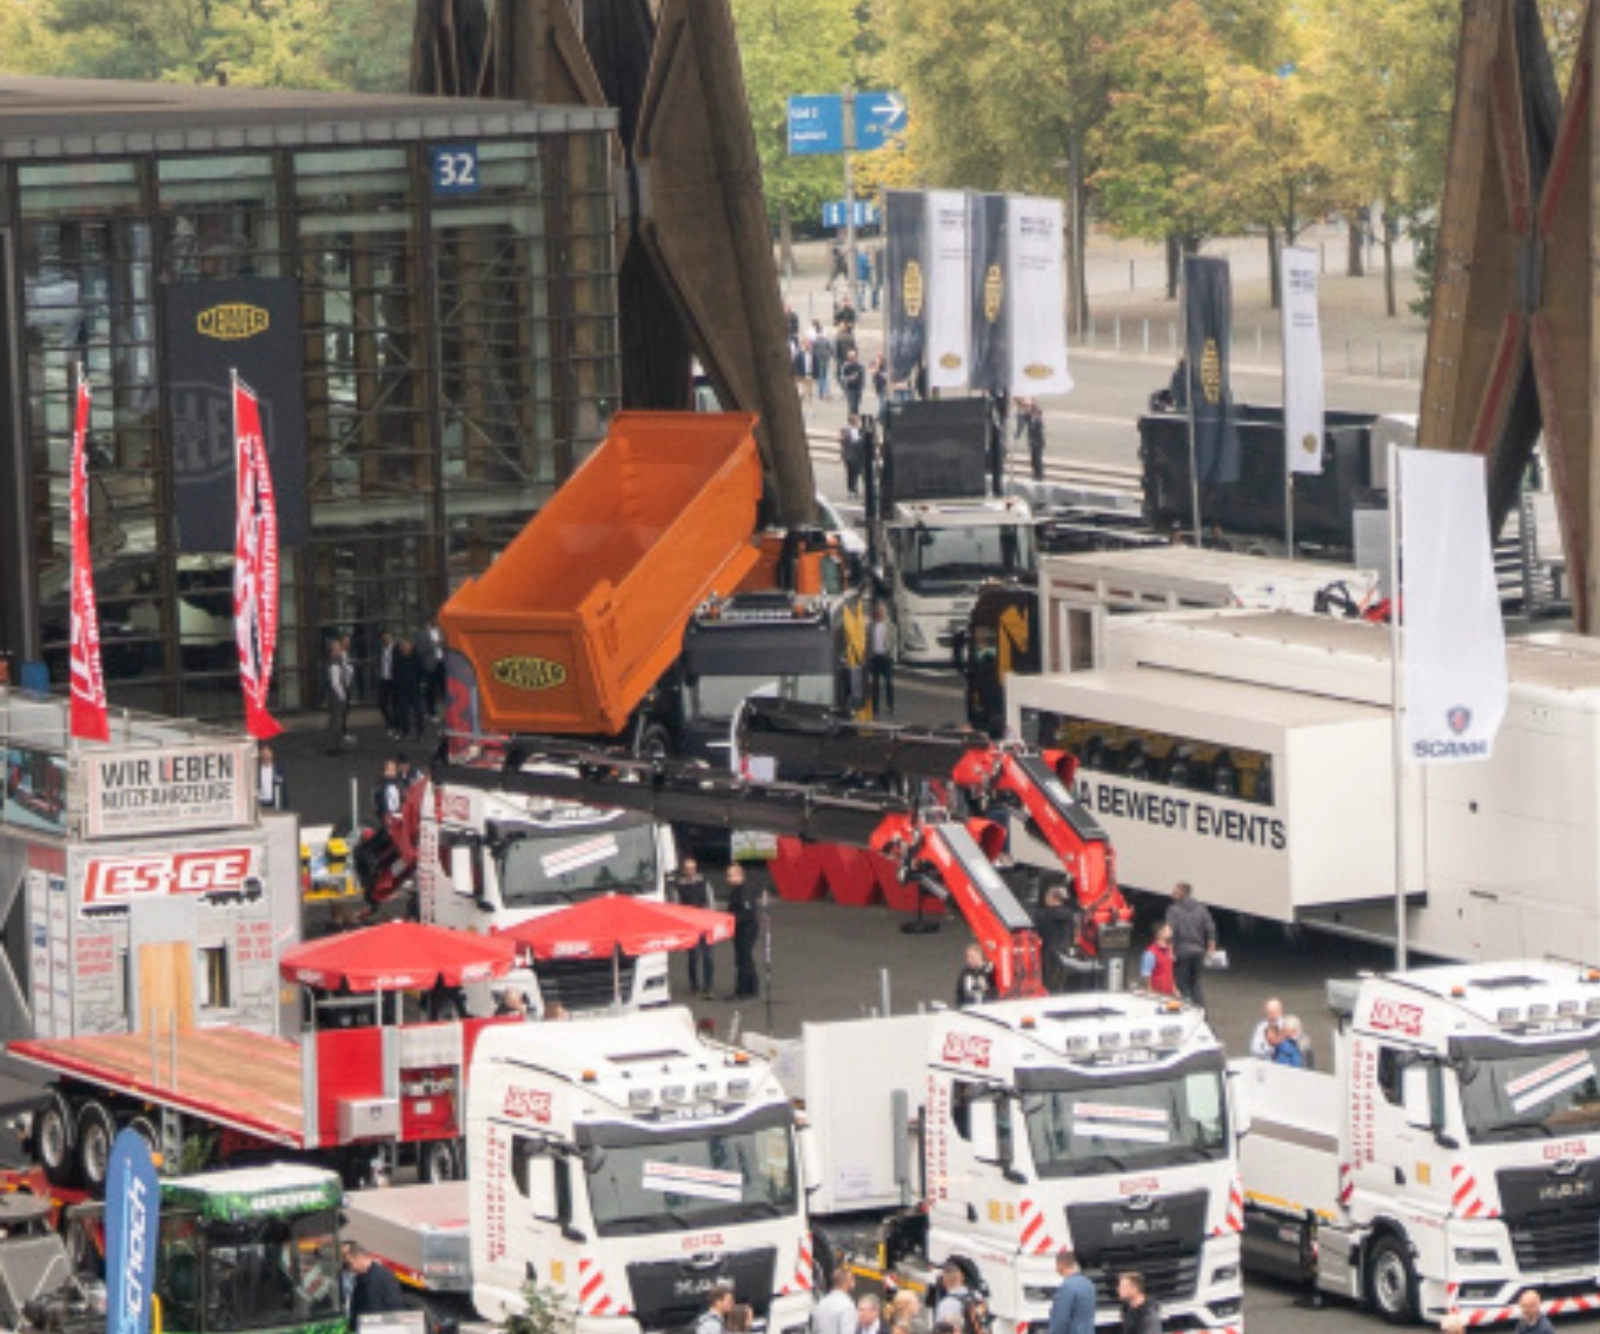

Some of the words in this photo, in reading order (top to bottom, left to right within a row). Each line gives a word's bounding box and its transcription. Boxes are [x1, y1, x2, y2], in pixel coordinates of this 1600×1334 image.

[439, 153, 474, 186] 32
[101, 760, 152, 787] WIR
[158, 753, 233, 783] LEBEN
[1098, 784, 1191, 829] BEWEGT
[1196, 807, 1286, 850] EVENTS
